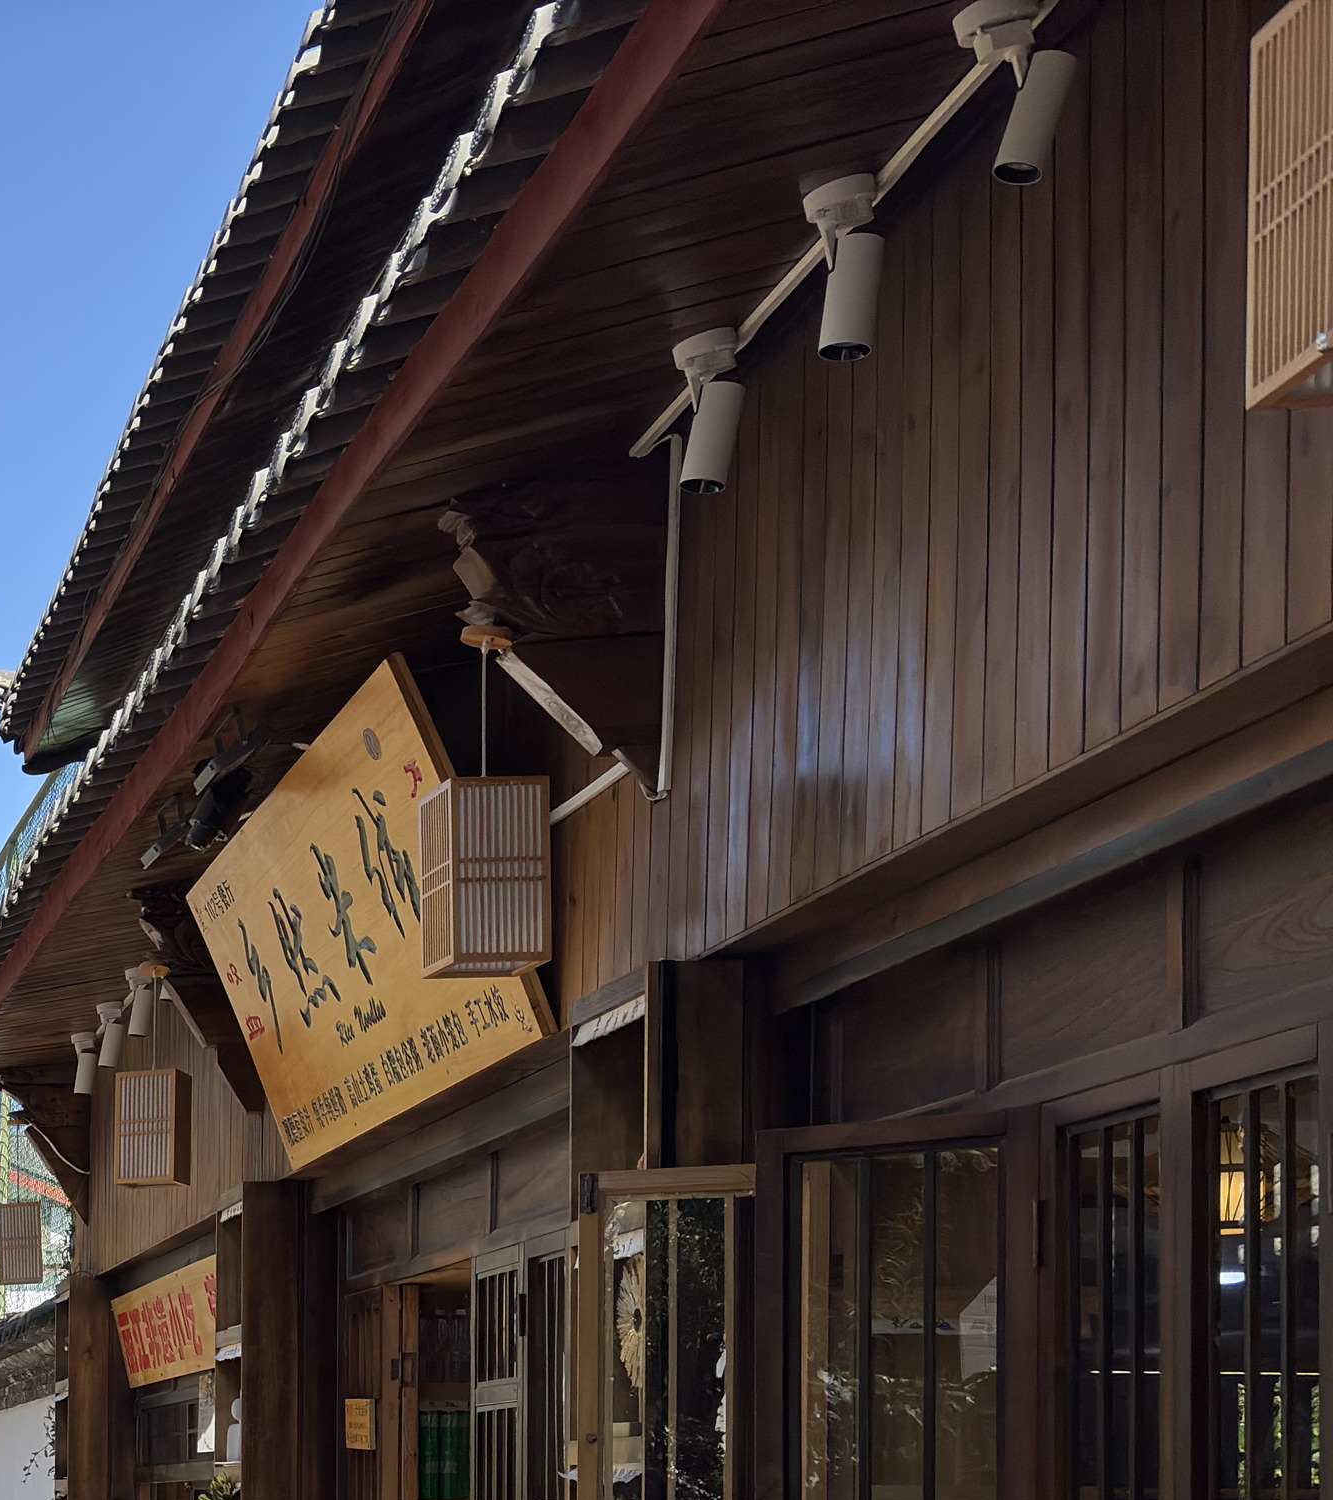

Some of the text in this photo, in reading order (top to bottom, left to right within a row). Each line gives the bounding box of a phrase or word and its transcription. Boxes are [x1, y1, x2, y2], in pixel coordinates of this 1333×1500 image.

[204, 879, 236, 923] 102号餐厅
[336, 997, 387, 1047] Rice Noodles
[343, 1061, 384, 1109] 高山土鸡蛋
[420, 1010, 469, 1064] 老面小笼包
[465, 984, 510, 1037] 手工水饺
[117, 1285, 203, 1375] 丽江非遗小吃
